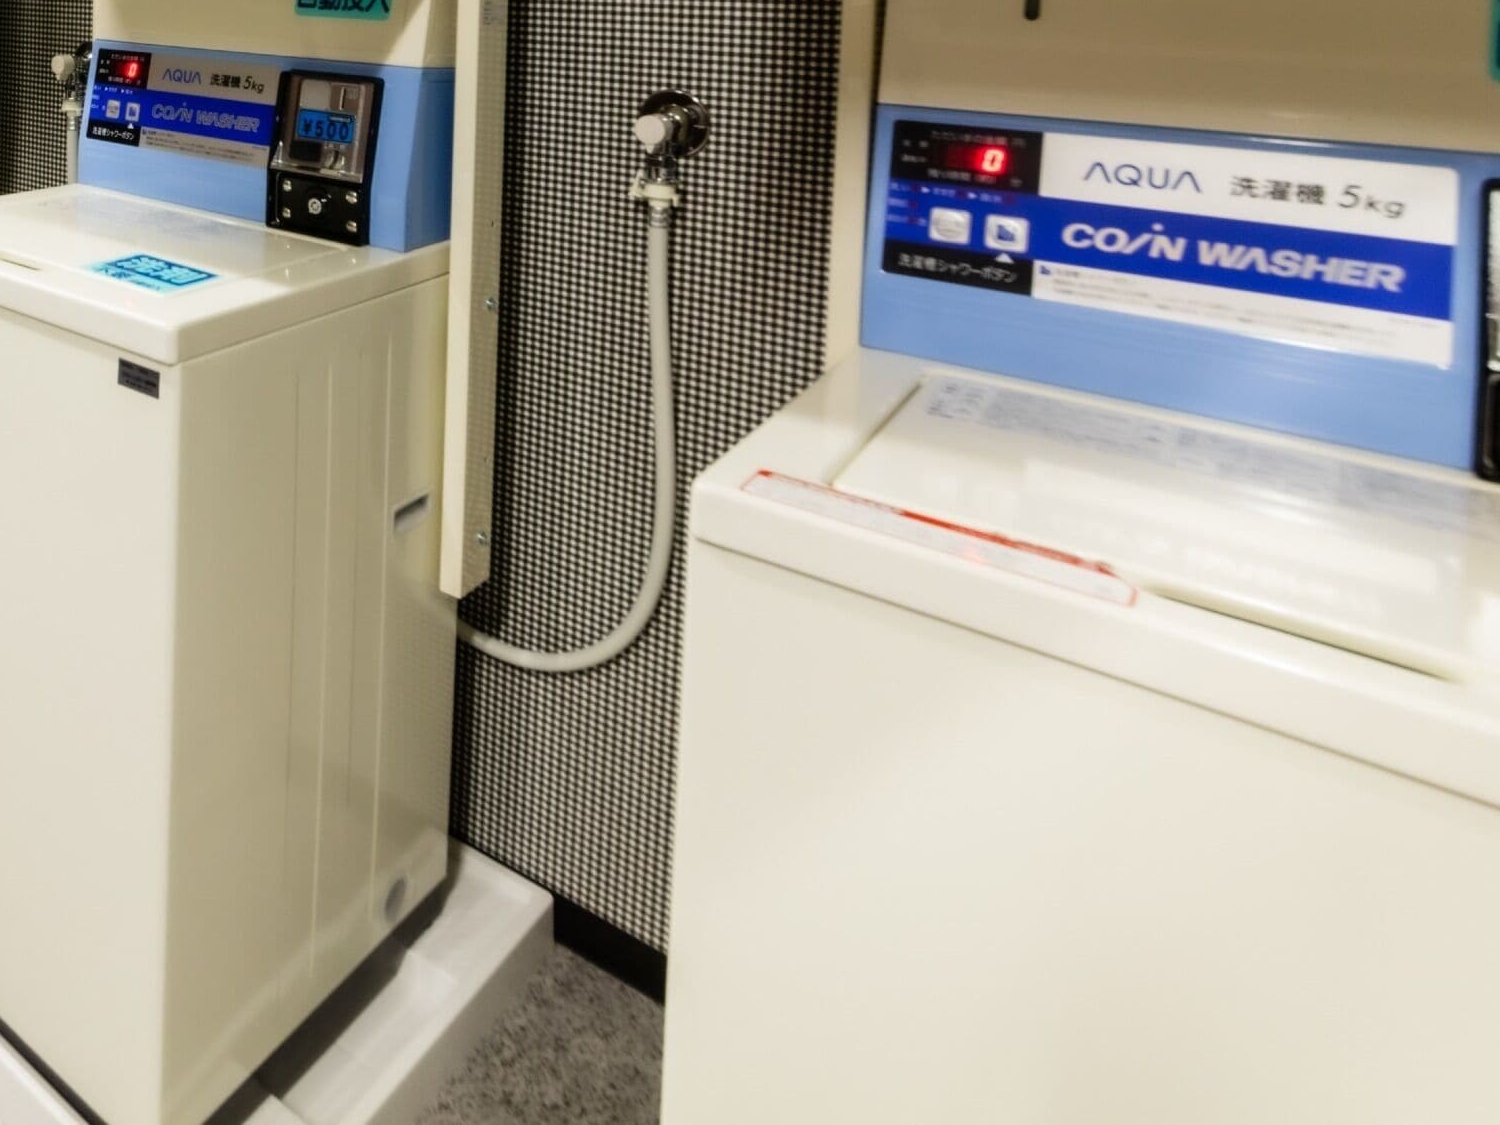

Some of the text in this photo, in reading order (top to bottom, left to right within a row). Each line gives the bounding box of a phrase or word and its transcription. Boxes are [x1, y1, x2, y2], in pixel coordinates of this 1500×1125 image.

[161, 68, 265, 94] AQUA 洗濯機 5kg
[195, 109, 261, 133] WASHER
[981, 148, 1006, 174] 0
[1083, 161, 1406, 220] AQUA 洗濯機 5kg
[1197, 241, 1408, 293] WASHER
